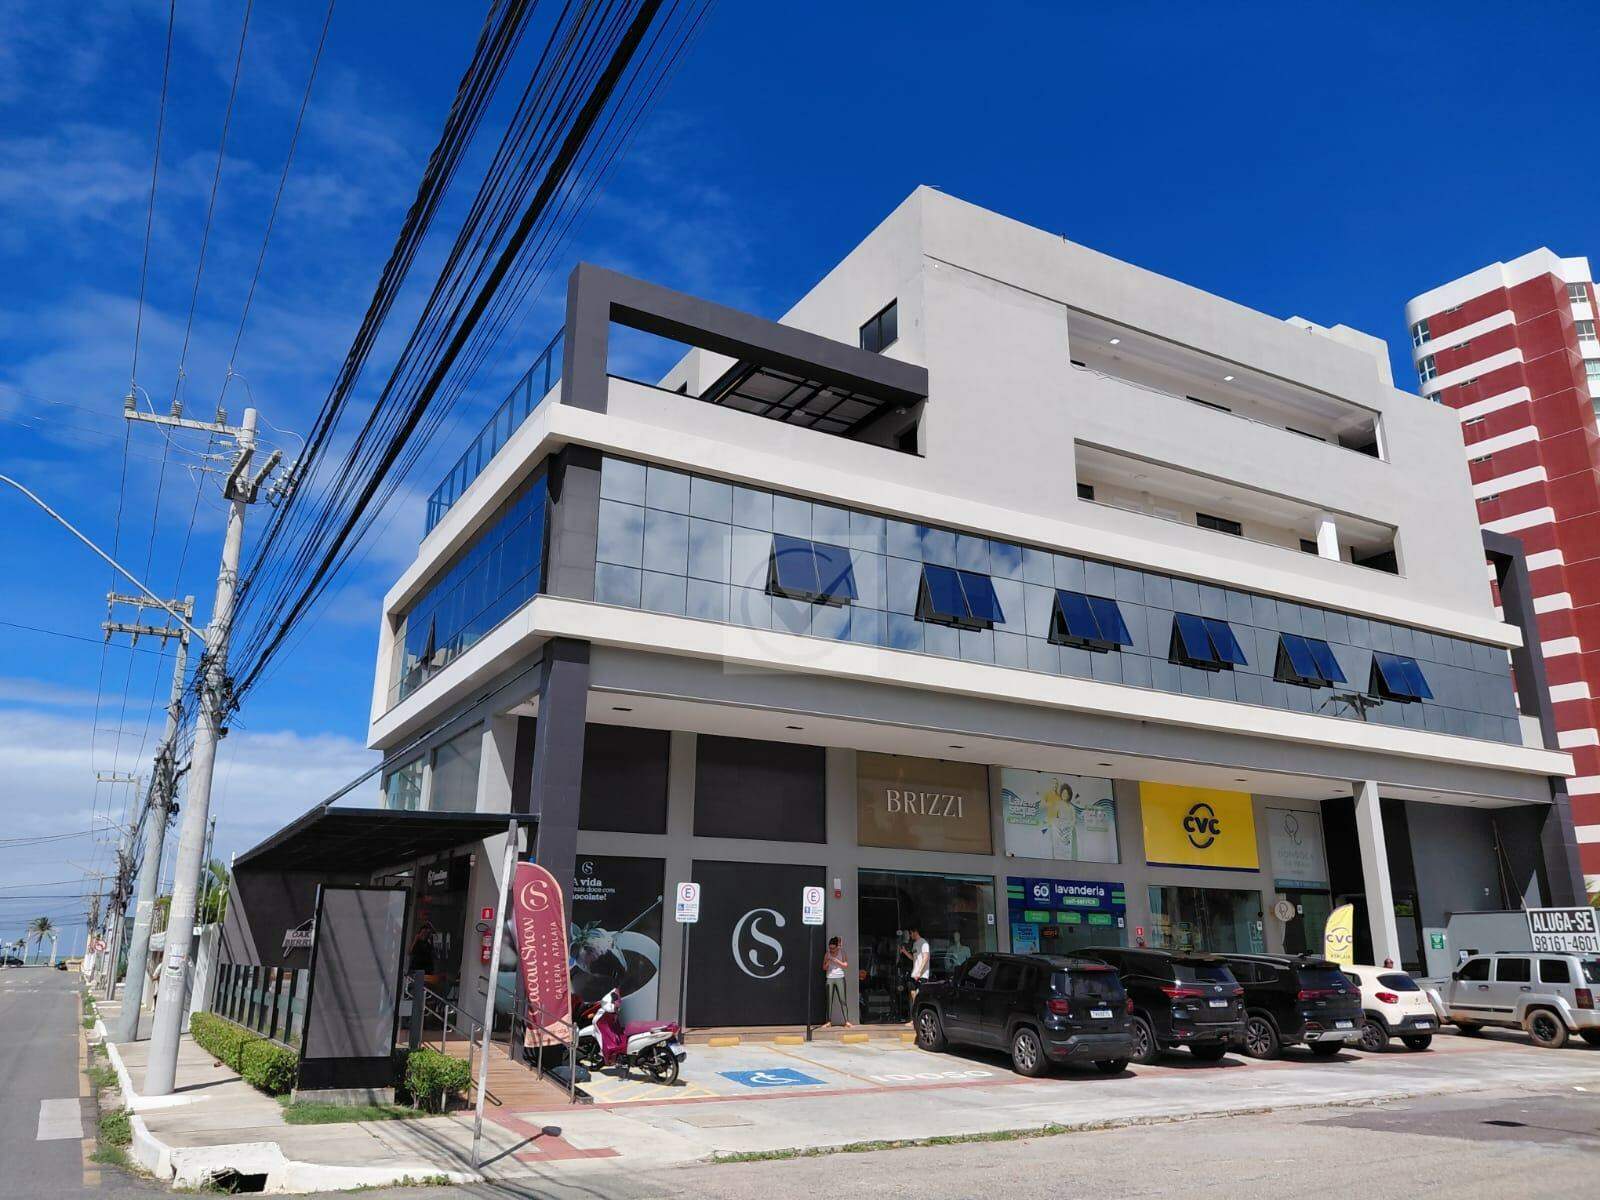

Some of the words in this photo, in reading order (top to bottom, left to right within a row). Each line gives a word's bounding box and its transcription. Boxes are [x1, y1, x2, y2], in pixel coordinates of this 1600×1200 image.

[886, 789, 963, 818] BRIZZI
[1183, 816, 1221, 835] CVC
[580, 877, 602, 887] vida
[685, 887, 692, 899] E
[810, 891, 817, 902] E
[1033, 885, 1050, 897] 60
[1055, 884, 1105, 896] lavanderia
[1532, 911, 1594, 932] ALUGA-SE
[550, 921, 560, 957] ATALAIA
[1326, 934, 1352, 944] CVC
[1534, 935, 1600, 951] 98161-4601
[551, 964, 563, 1000] GALERIA
[868, 1070, 993, 1082] IDOSO
